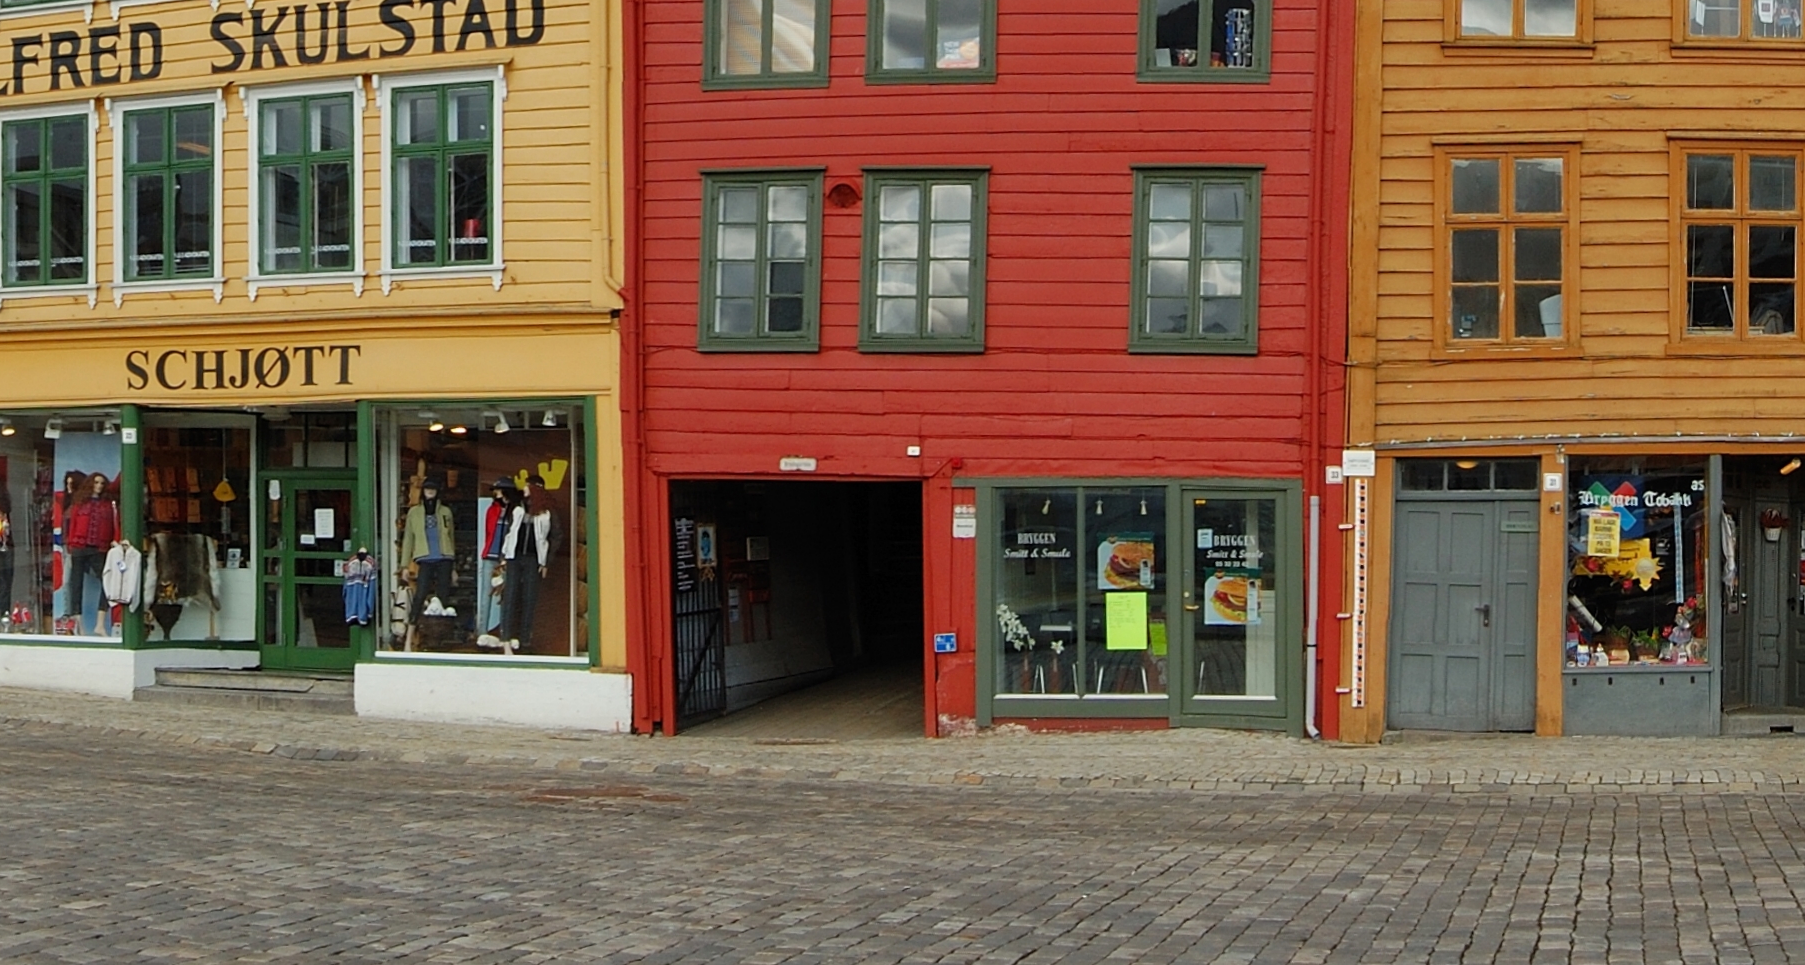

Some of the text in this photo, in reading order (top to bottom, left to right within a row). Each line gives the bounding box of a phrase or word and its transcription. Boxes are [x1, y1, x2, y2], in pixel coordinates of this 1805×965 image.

[125, 345, 361, 390] SCHJØTT
[1690, 479, 1705, 491] as
[1578, 490, 1638, 507] Bryggen
[1017, 533, 1056, 545] BRYGGEN
[1214, 535, 1256, 547] BRYGGEN
[1030, 548, 1039, 558] &
